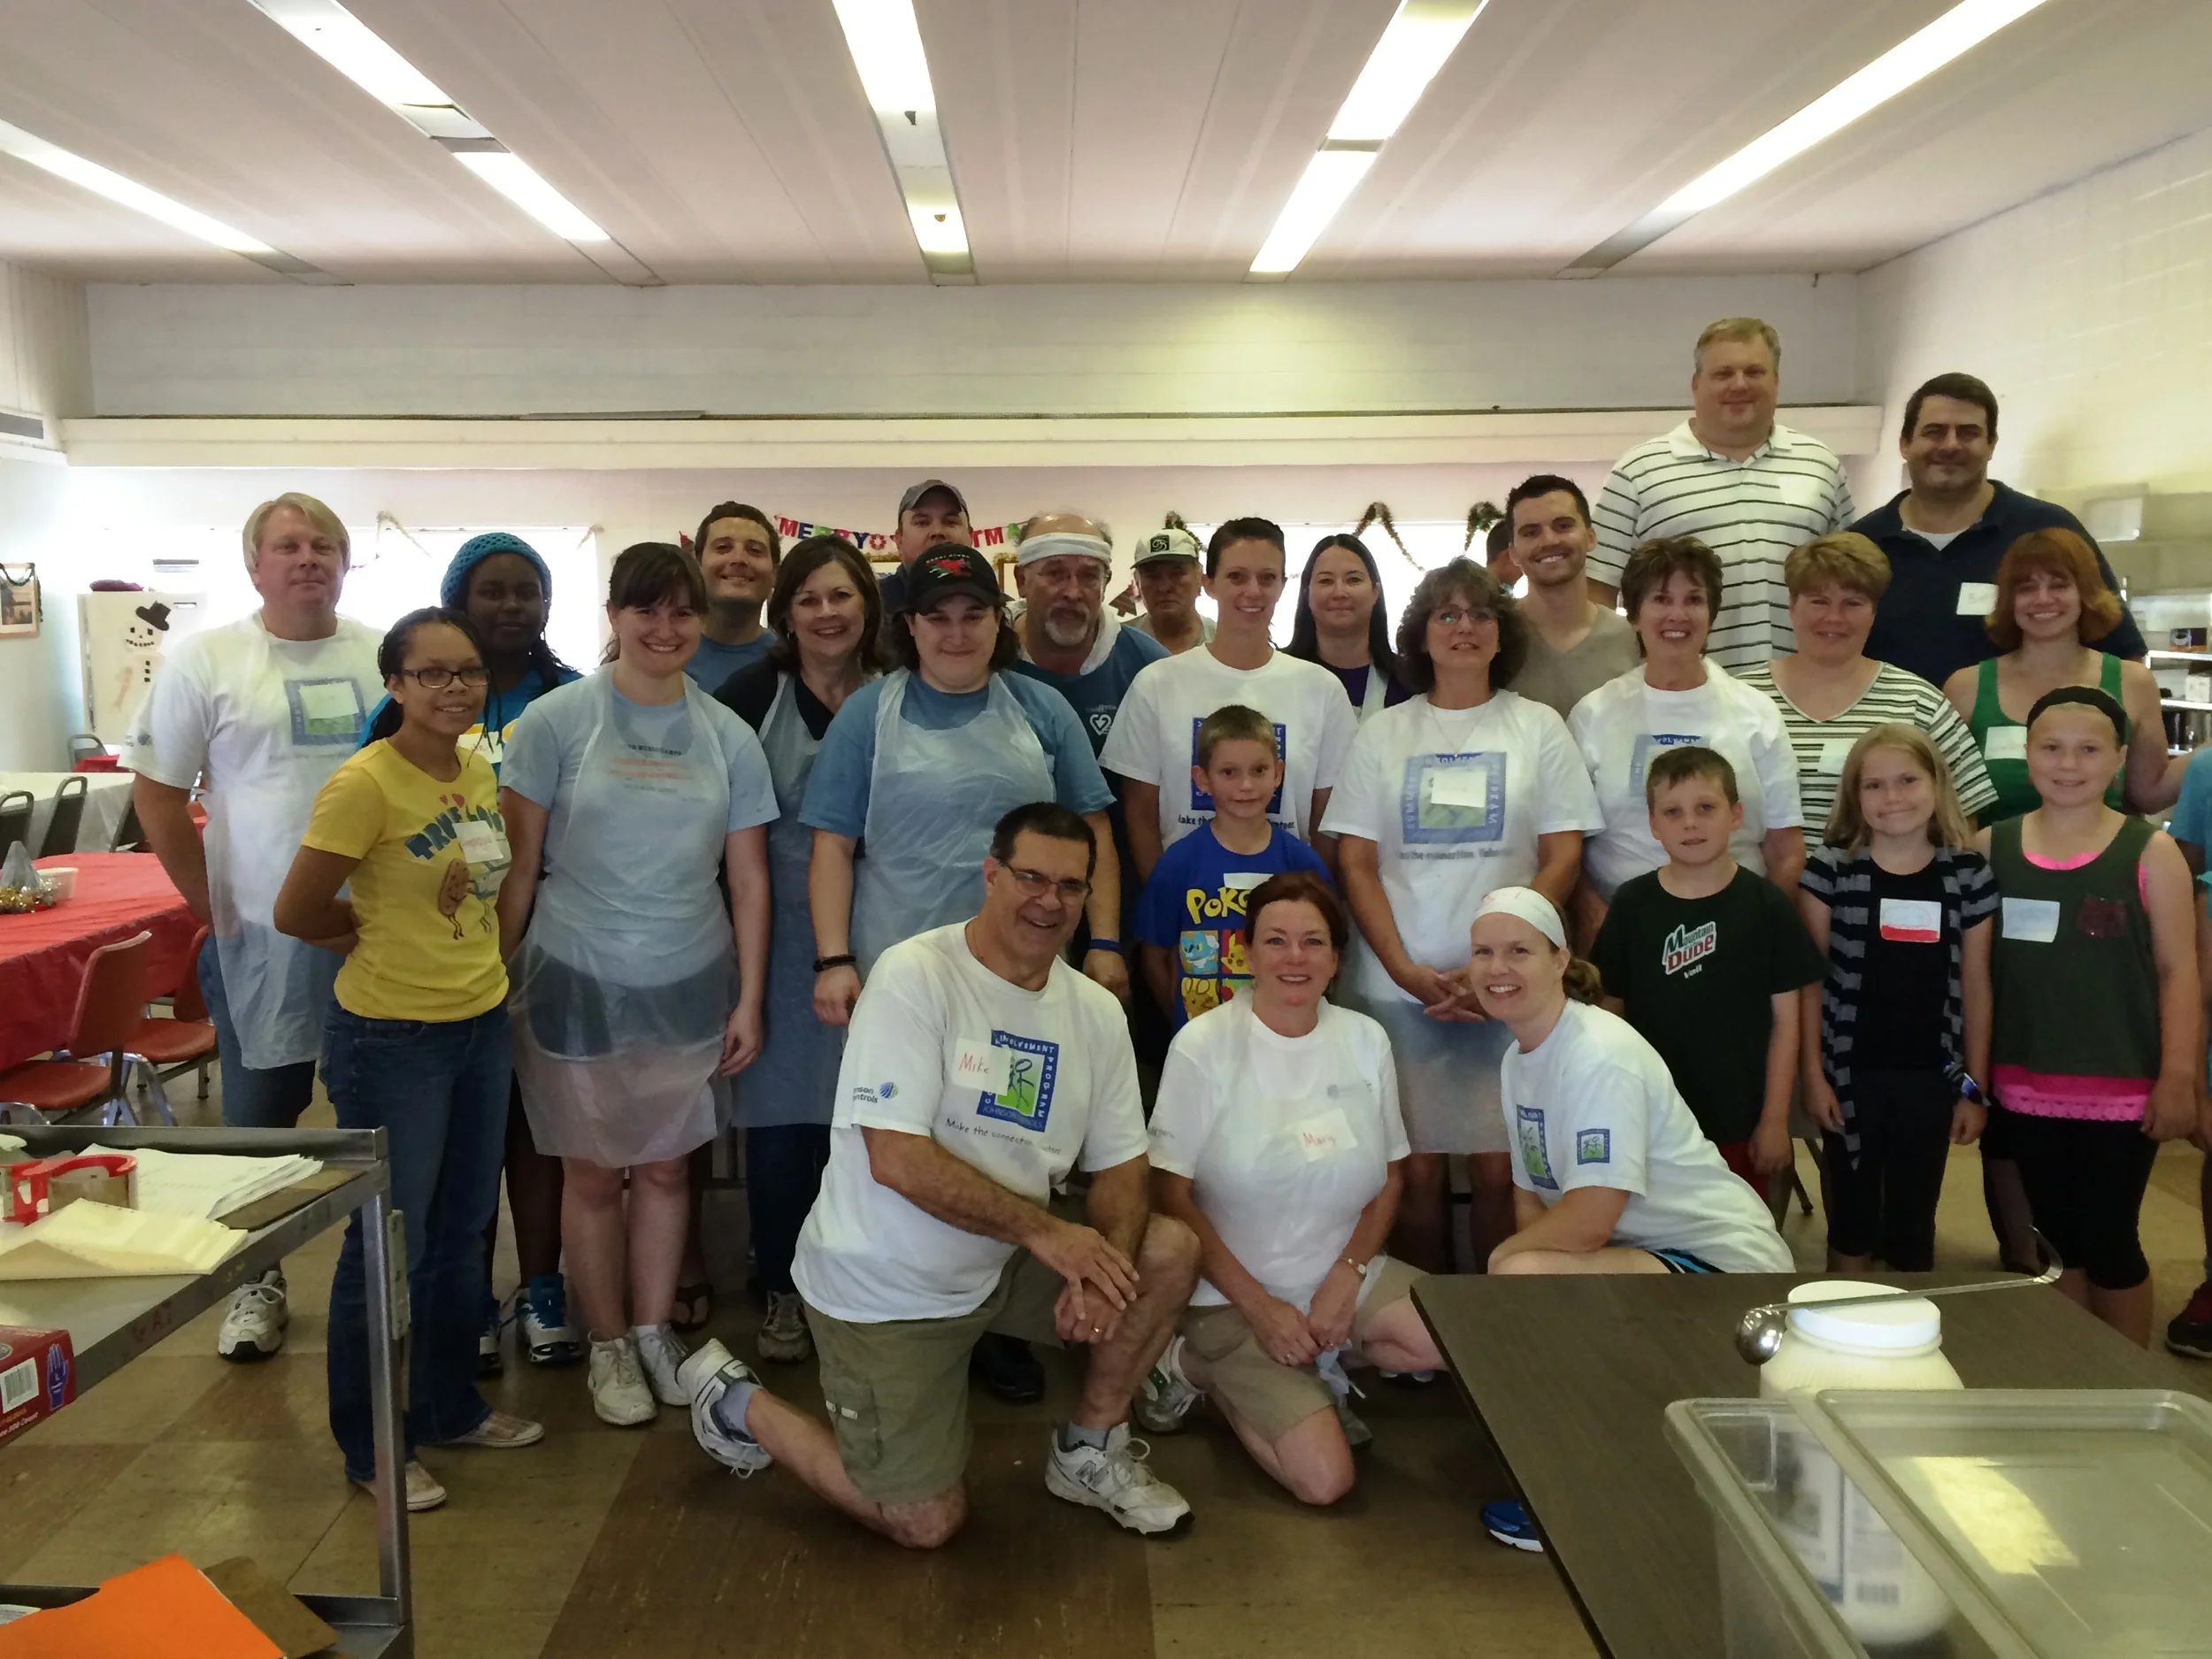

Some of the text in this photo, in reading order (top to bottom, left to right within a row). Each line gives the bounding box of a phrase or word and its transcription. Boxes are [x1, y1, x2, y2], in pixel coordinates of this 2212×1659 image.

[958, 1053, 989, 1073] Mike
[1038, 1056, 1054, 1118] PROGRAM
[946, 1118, 970, 1133] Make
[973, 1125, 988, 1137] the
